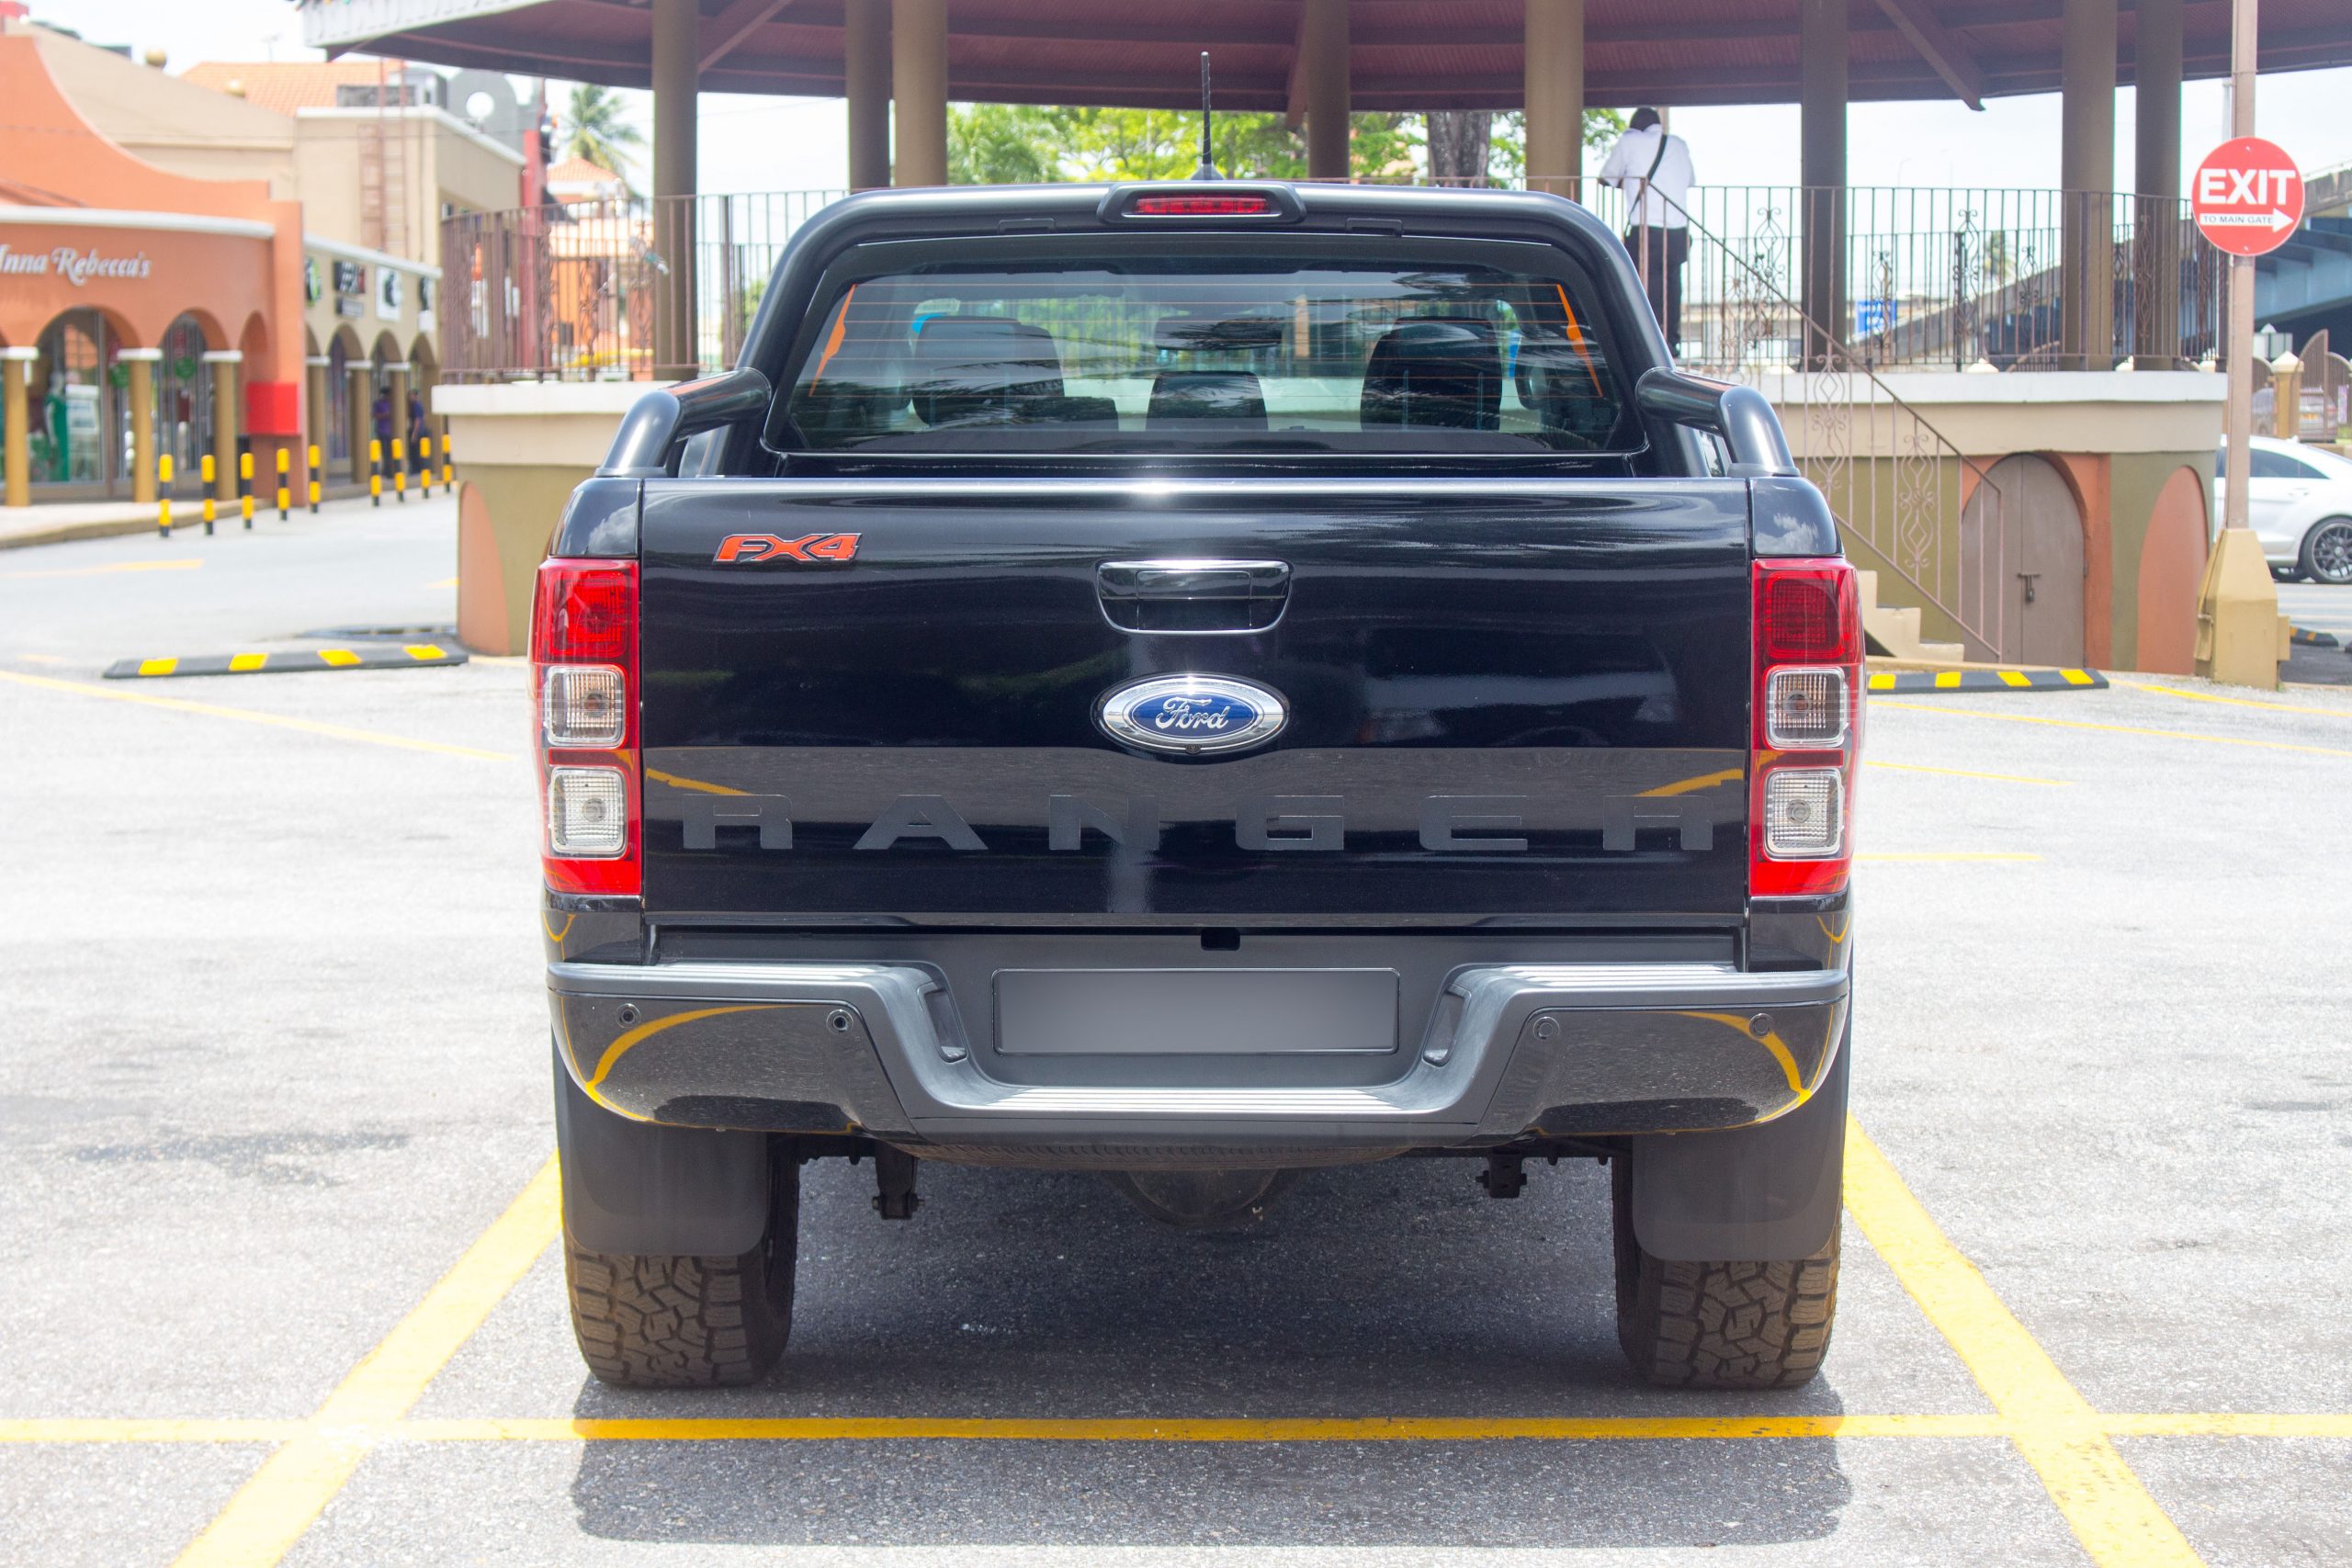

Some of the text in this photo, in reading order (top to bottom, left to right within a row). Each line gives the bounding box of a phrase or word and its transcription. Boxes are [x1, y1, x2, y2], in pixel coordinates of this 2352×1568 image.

[2199, 168, 2296, 205] EXIT
[2203, 215, 2274, 225] TO MAIN GATE
[51, 246, 152, 287] Rebecca's
[712, 533, 862, 565] FX4
[1155, 696, 1231, 729] Ford
[683, 794, 1713, 851] RANGER
